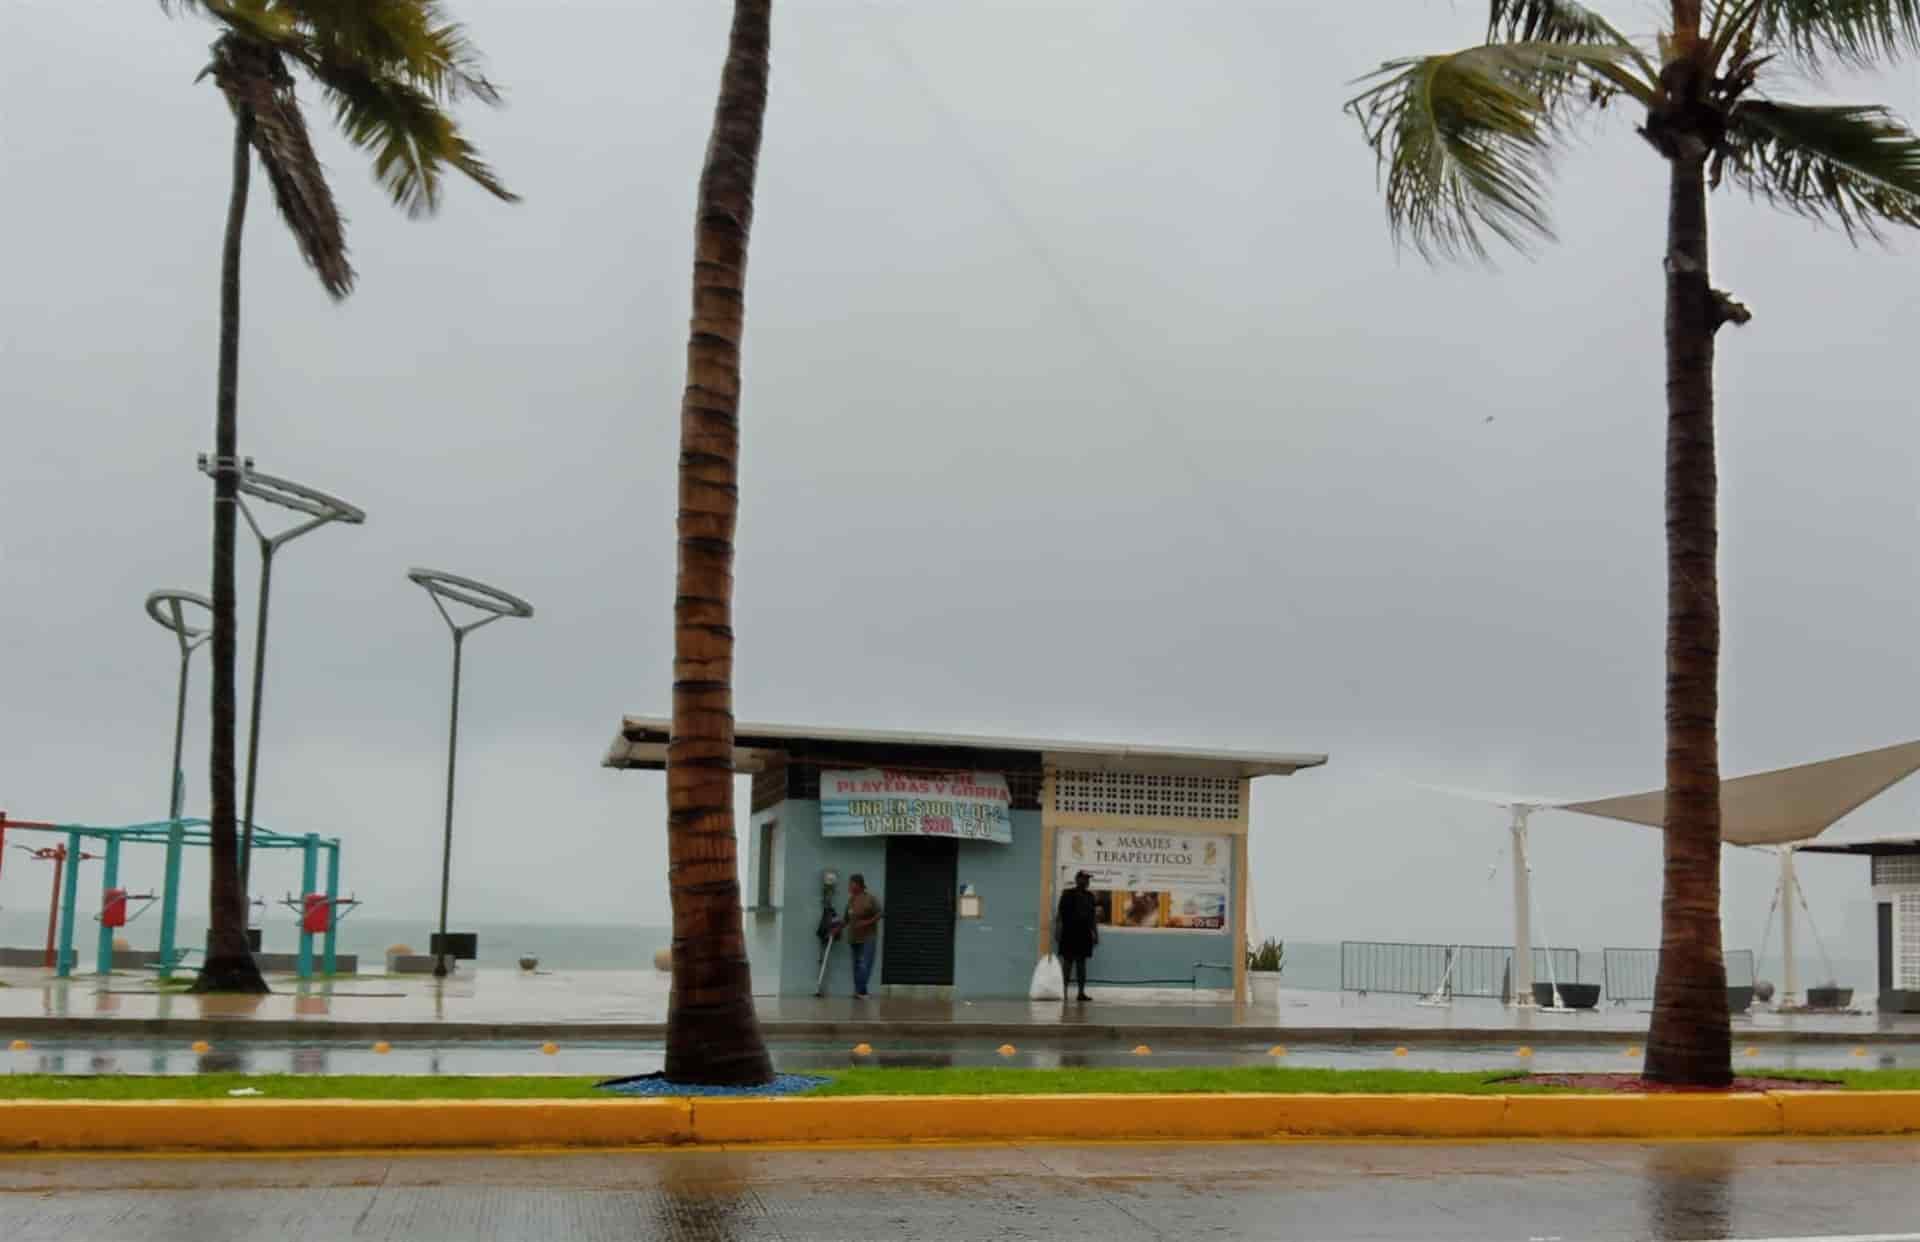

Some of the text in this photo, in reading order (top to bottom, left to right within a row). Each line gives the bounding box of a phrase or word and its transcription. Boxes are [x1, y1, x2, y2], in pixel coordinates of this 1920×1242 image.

[836, 779, 928, 794] PLAYERAS
[935, 782, 946, 794] Y
[848, 799, 884, 817] UNA
[887, 799, 911, 817] EN
